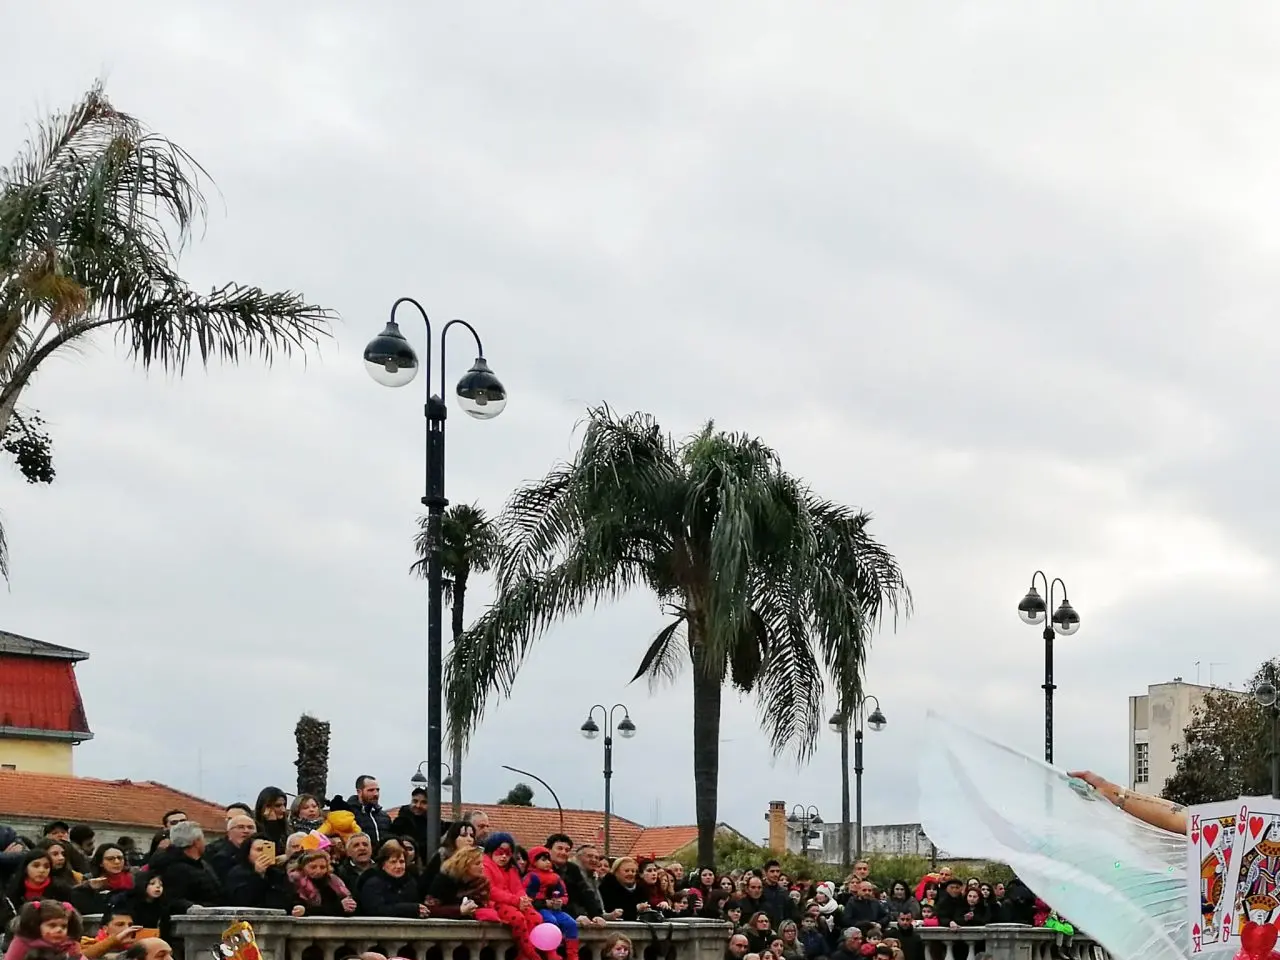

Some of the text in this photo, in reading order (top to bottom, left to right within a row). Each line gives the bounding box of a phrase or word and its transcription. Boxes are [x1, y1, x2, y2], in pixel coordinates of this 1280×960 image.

[1240, 805, 1247, 821] Q
[1192, 815, 1200, 830] K
[1192, 936, 1201, 952] K
